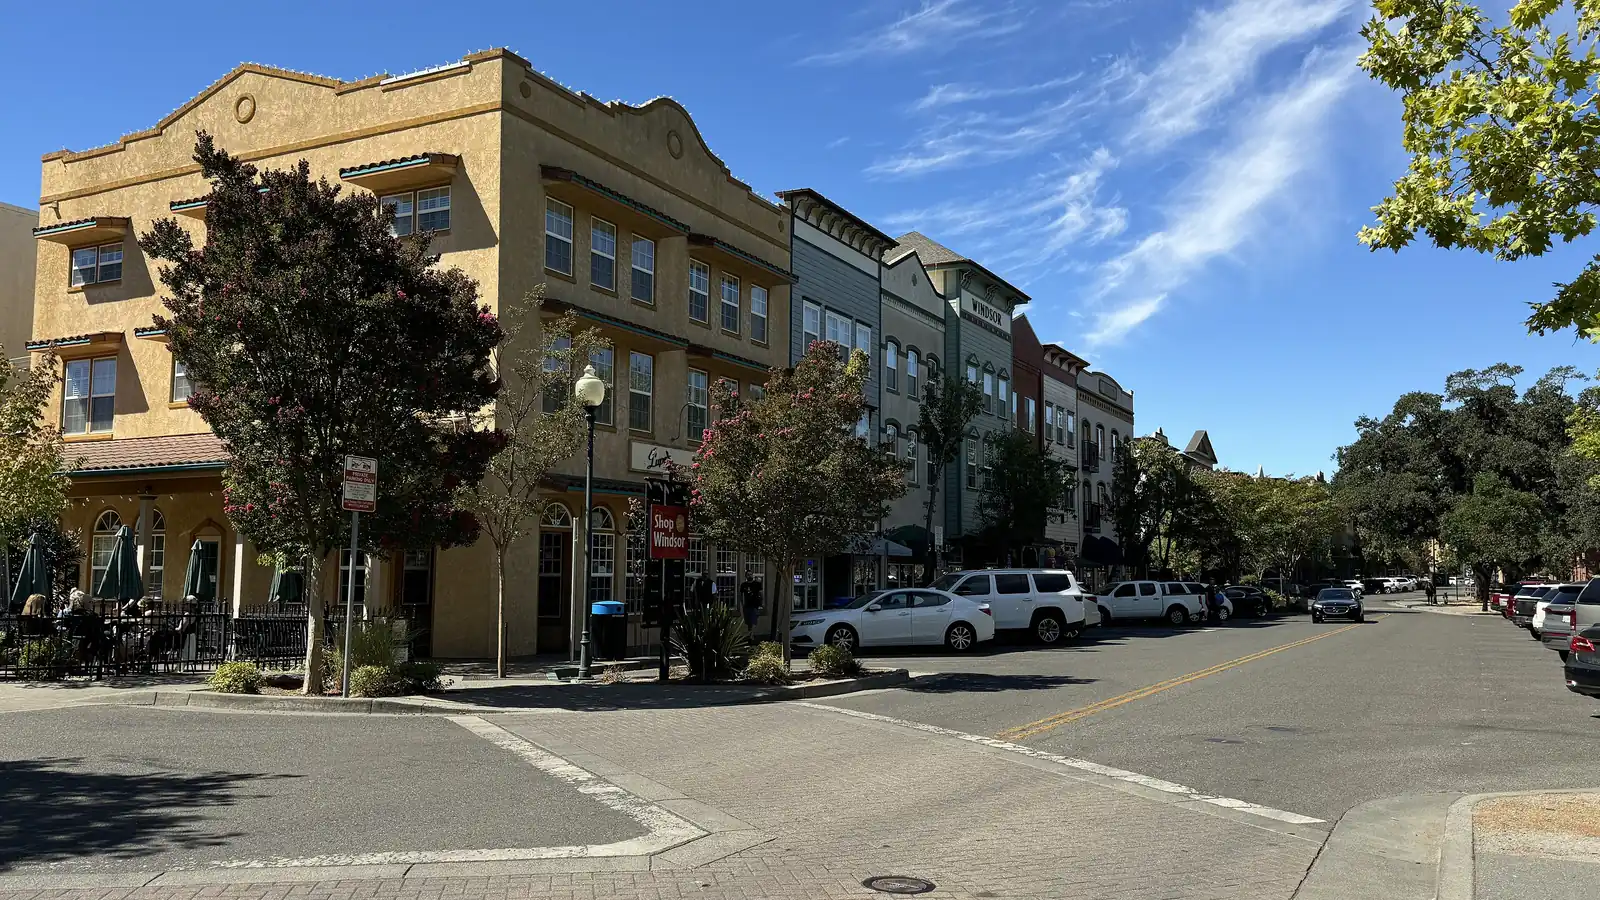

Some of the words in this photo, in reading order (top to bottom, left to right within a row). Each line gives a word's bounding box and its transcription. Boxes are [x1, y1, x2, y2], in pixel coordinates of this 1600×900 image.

[971, 297, 1002, 326] WINDSOR
[654, 514, 674, 532] Shop
[653, 531, 686, 548] Windsor
